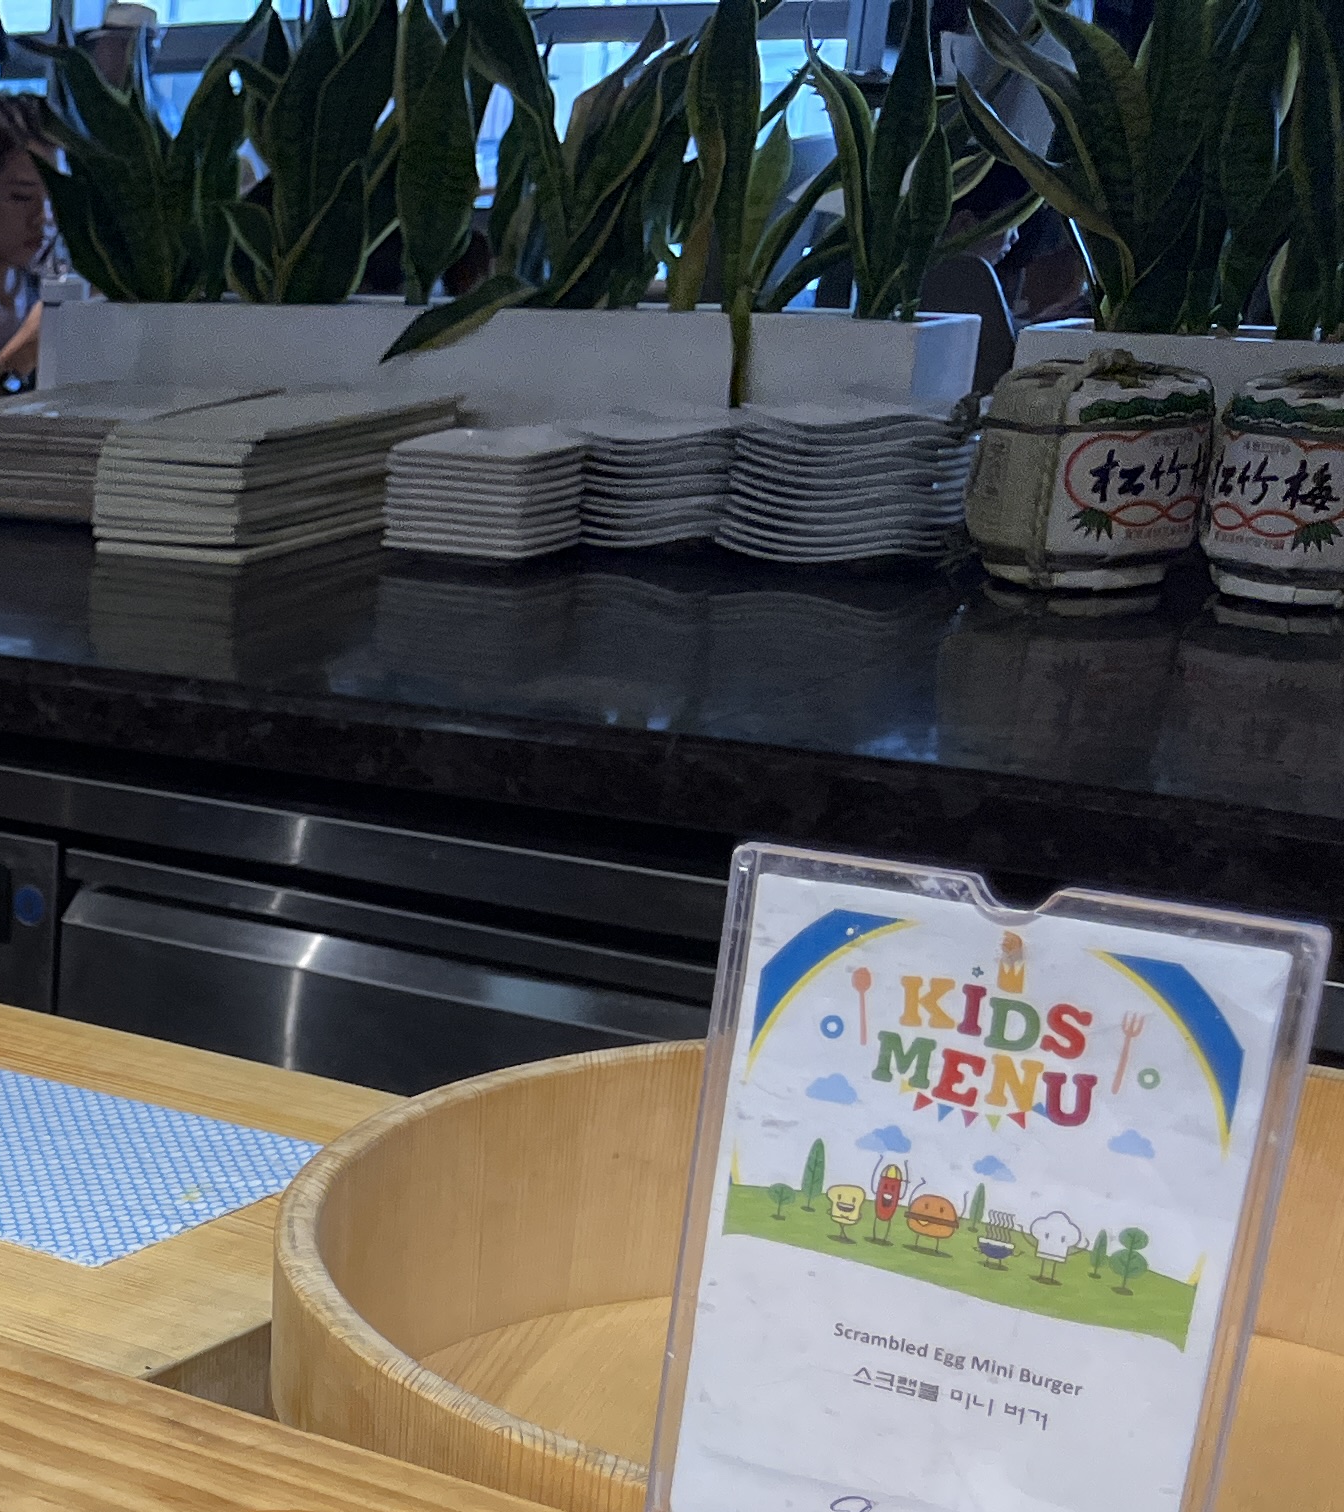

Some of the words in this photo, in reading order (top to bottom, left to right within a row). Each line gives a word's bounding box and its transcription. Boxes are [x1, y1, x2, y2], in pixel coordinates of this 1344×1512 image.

[899, 975, 1093, 1060] KIDS
[871, 1030, 1098, 1127] MENU
[833, 1322, 930, 1359] Scrambled
[933, 1347, 967, 1370] Egg
[970, 1355, 1014, 1380] Mini
[1019, 1367, 1084, 1397] Burger
[852, 1366, 940, 1403] 스크램블
[950, 1388, 995, 1417] 미니
[1003, 1402, 1049, 1431] 버거
